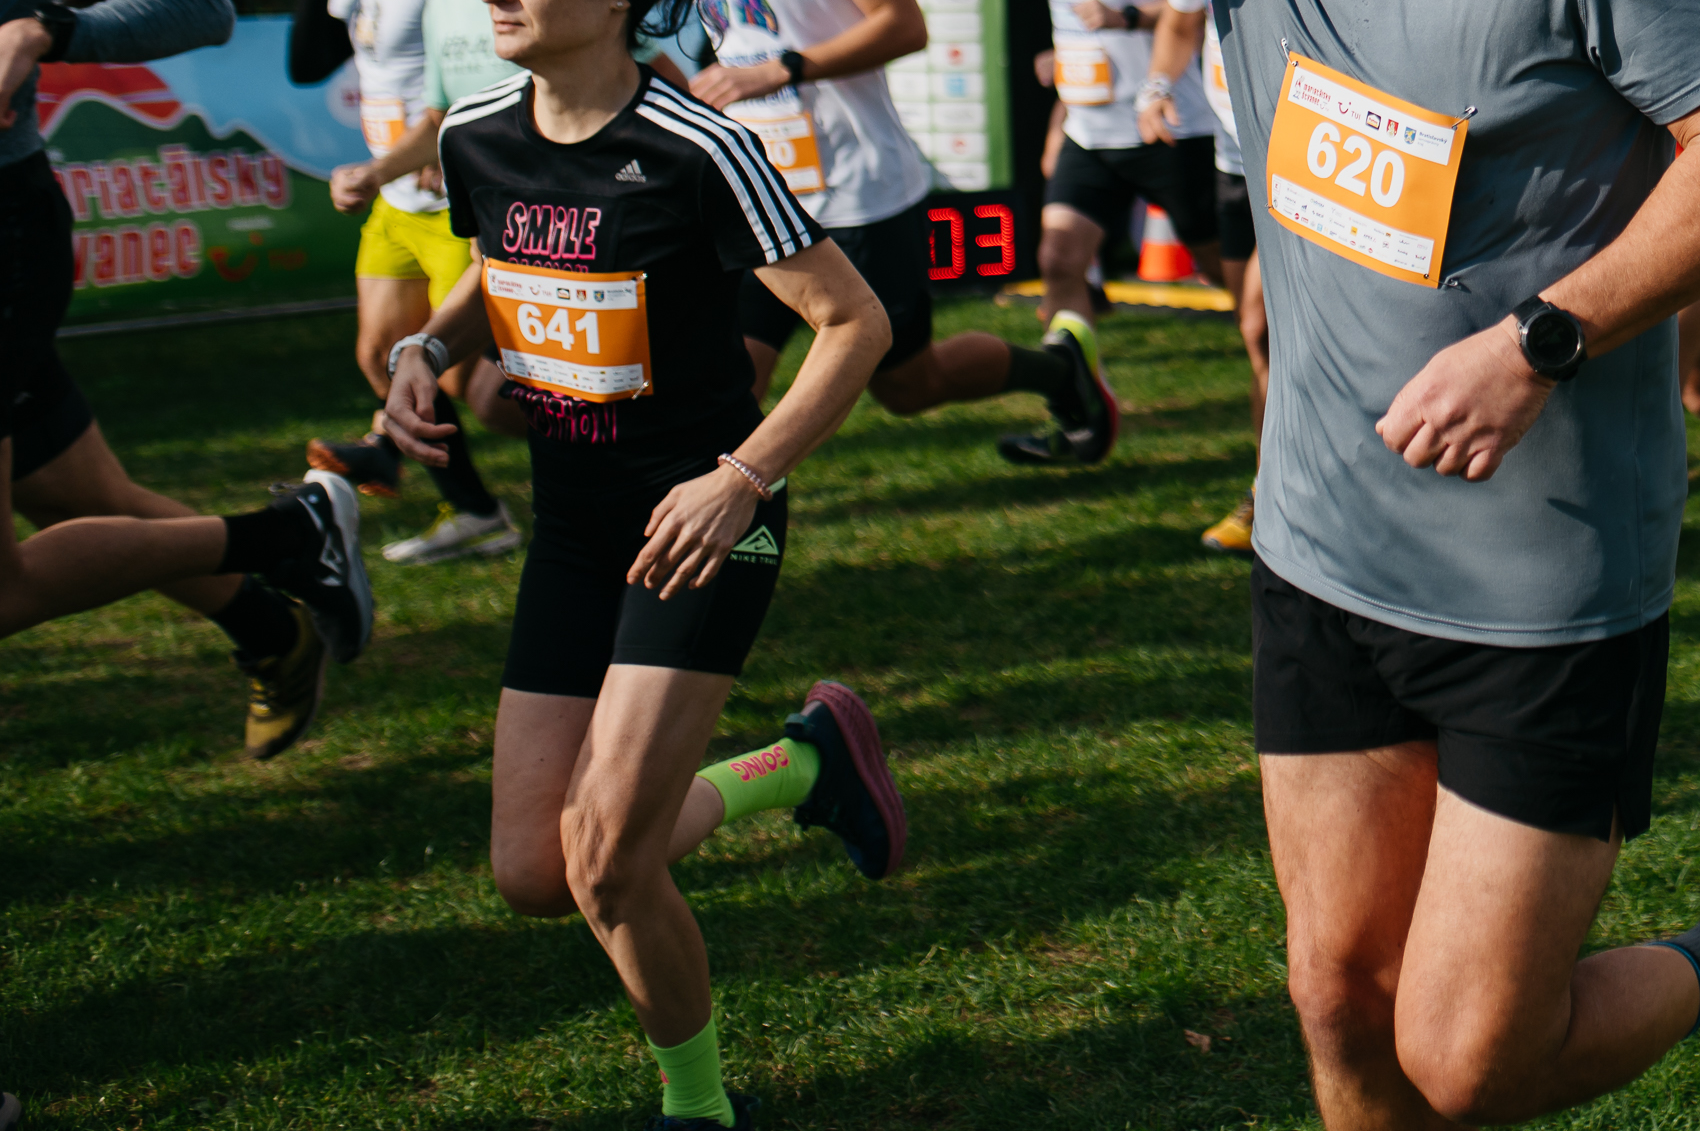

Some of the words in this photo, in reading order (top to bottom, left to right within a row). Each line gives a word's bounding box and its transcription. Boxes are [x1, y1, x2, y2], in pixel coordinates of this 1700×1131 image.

[1306, 122, 1405, 208] 620
[517, 302, 601, 354] 641
[729, 553, 757, 564] NIKE
[729, 745, 790, 783] GOING
